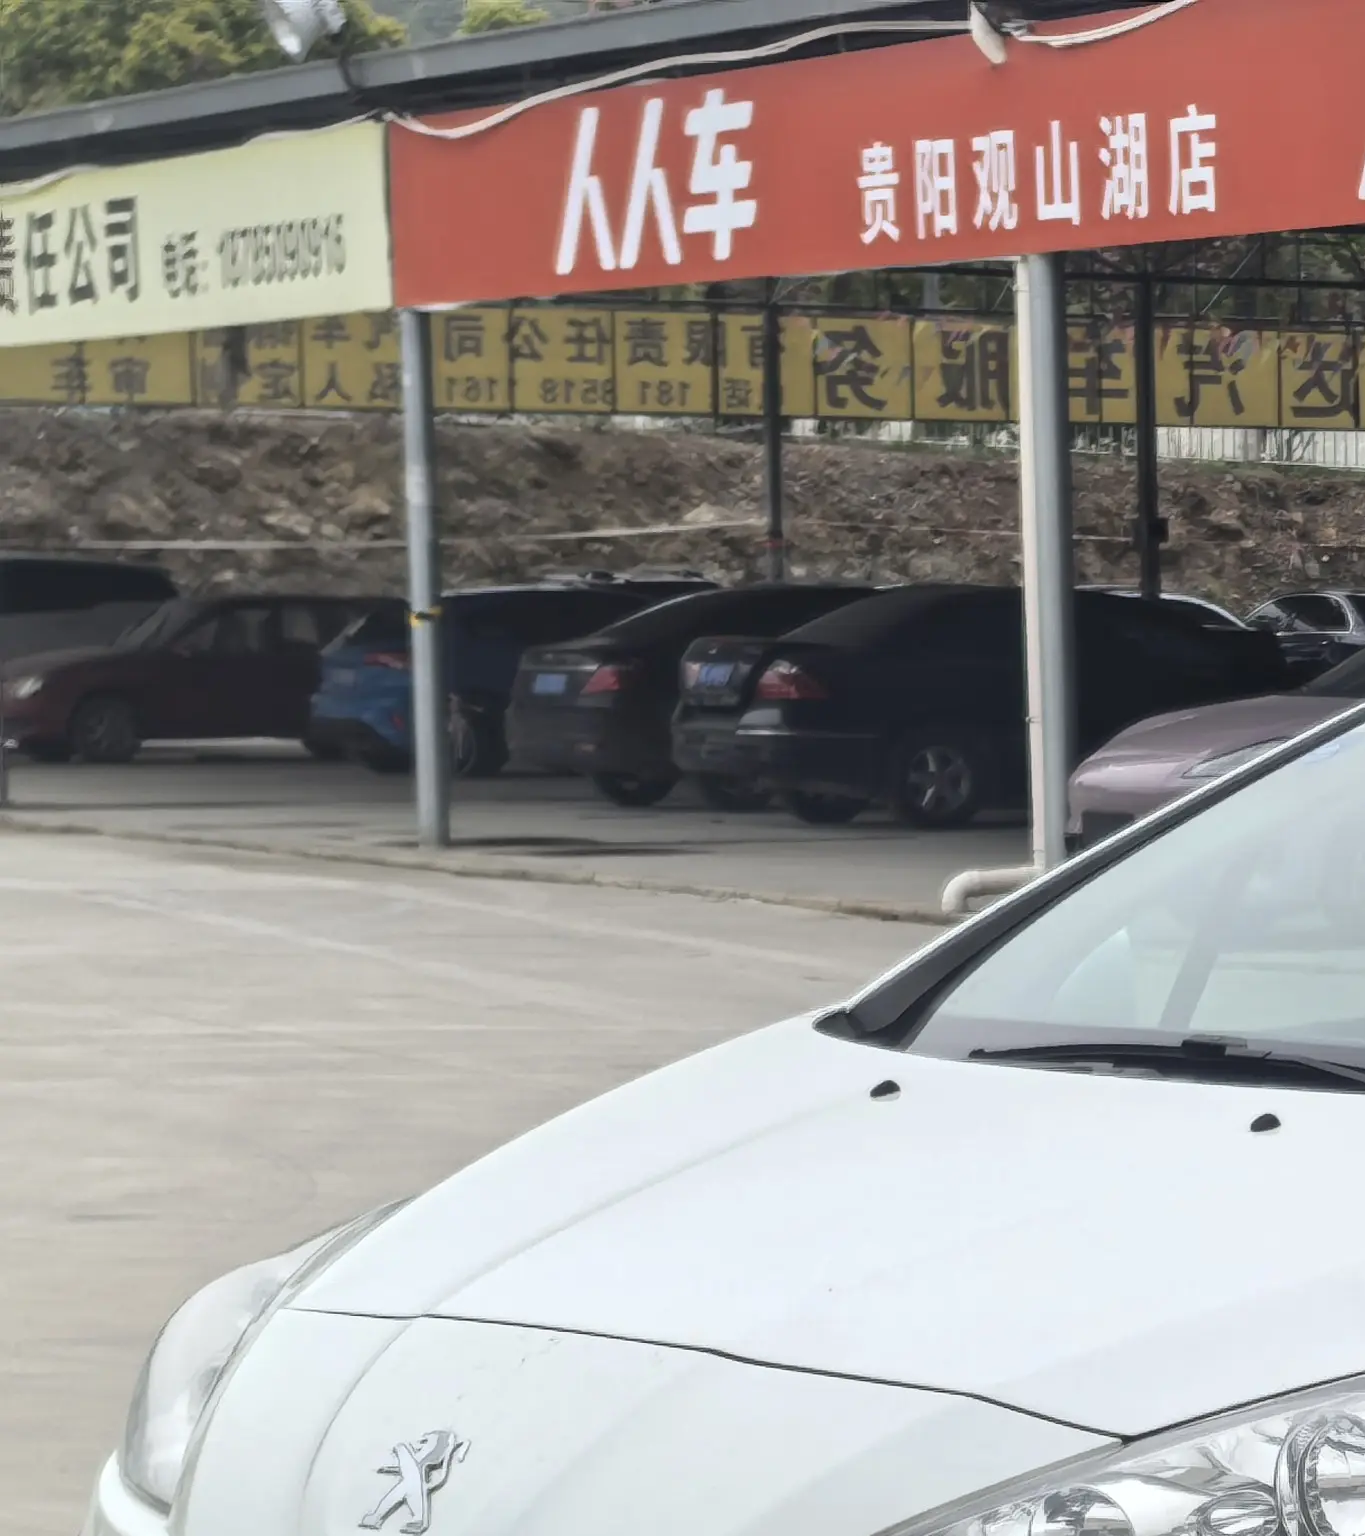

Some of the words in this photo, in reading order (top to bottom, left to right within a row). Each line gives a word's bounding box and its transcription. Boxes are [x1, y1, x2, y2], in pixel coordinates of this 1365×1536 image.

[554, 88, 758, 275] 人人车
[857, 104, 1217, 246] 贵阳观山湖店
